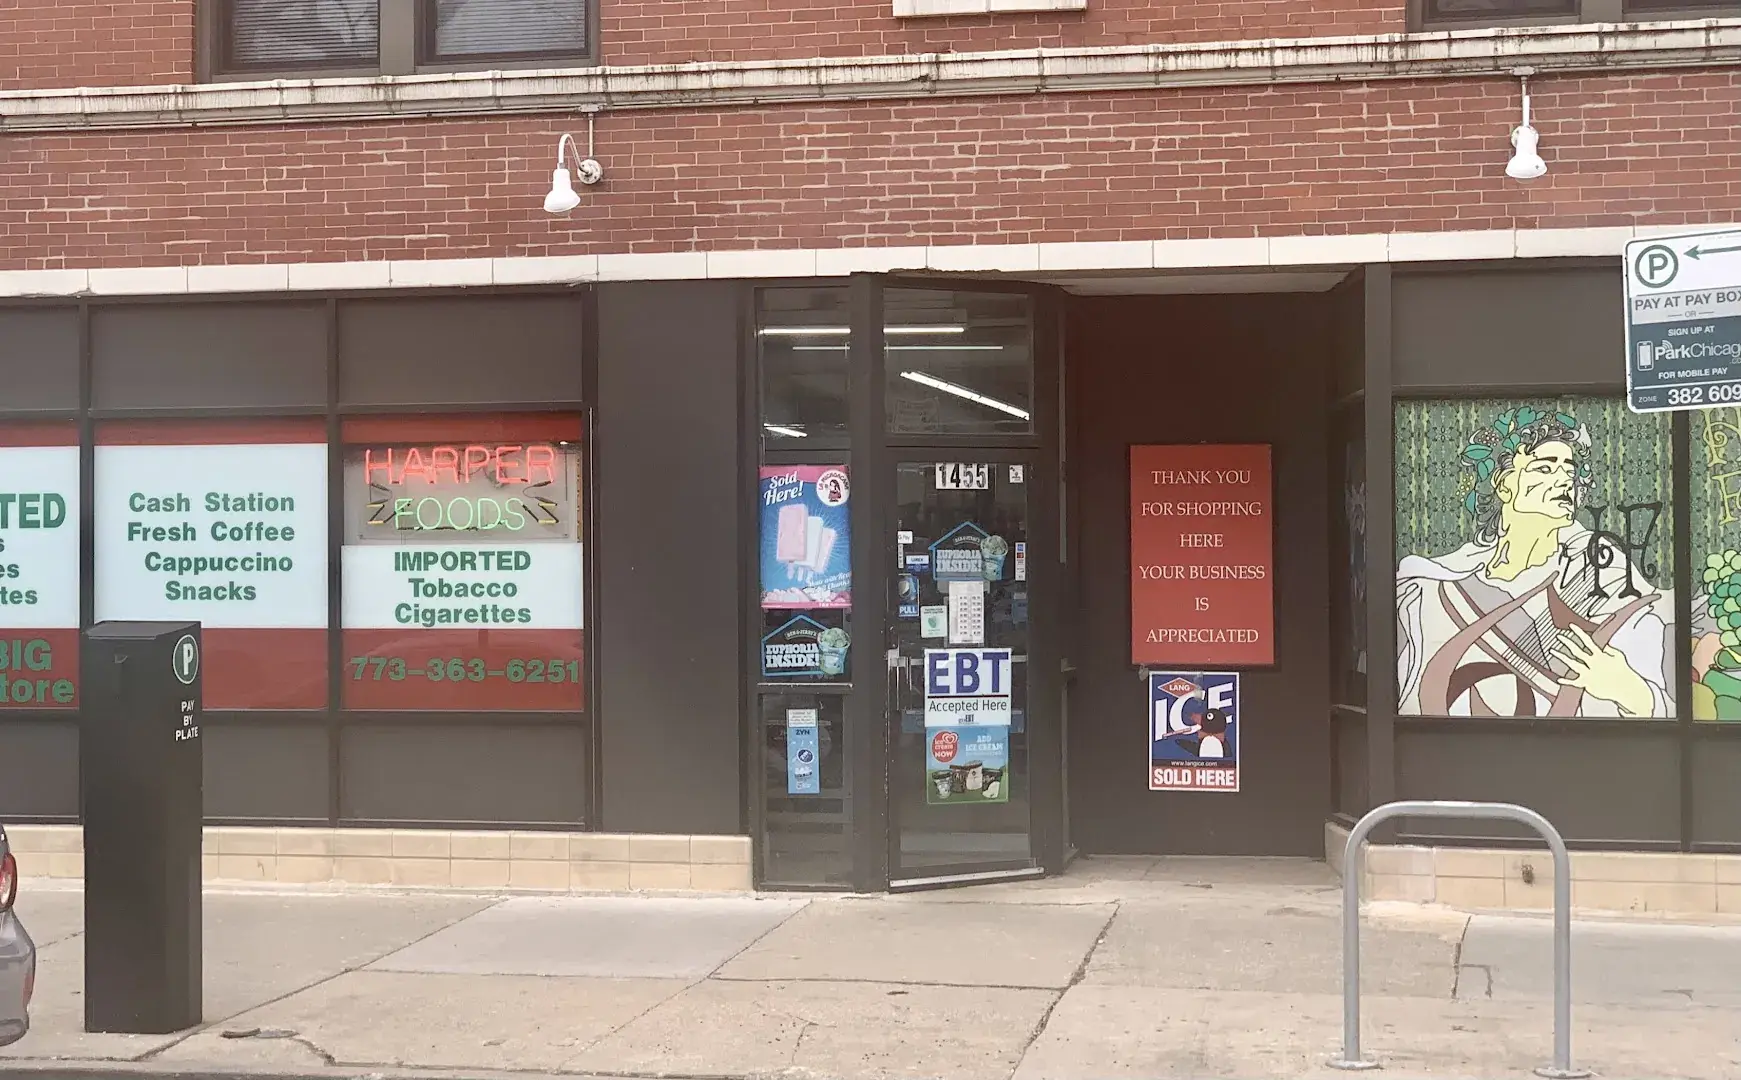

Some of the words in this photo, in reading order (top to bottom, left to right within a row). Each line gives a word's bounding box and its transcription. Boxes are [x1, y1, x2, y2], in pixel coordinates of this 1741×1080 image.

[1635, 299, 1660, 311] PAY
[1664, 296, 1681, 308] AT
[1685, 293, 1712, 306] PAY
[1668, 327, 1688, 336] SIGN
[1691, 327, 1702, 335] UP
[1704, 325, 1715, 334] AT
[1658, 371, 1675, 380] FOR
[1678, 368, 1709, 378] MOBILE
[1712, 367, 1728, 376] PAY
[1668, 387, 1703, 405] 382
[1709, 383, 1741, 402] 609
[364, 445, 559, 485] HARPER
[769, 471, 798, 489] Sold
[939, 463, 988, 488] 1455
[1151, 470, 1212, 485] THANK
[1216, 470, 1251, 485] YOU
[763, 480, 804, 506] Here!
[128, 492, 191, 512] Cash
[204, 492, 295, 513] Station
[1141, 502, 1173, 517] FOR
[1177, 502, 1262, 517] SHOPPING
[394, 496, 526, 531] FOODS
[127, 522, 196, 542] Fresh
[210, 522, 295, 542] Coffee
[1180, 533, 1224, 548] HERE
[144, 552, 293, 577] Cappuccino
[394, 551, 531, 572] IMPORTED
[936, 559, 982, 573] INSIDE!
[1139, 565, 1185, 580] YOUR
[1189, 565, 1265, 580] BUSINESS
[165, 581, 257, 601] Snacks
[408, 578, 518, 599] Tobacco
[900, 605, 916, 614] PULL
[1195, 597, 1209, 611] IS
[394, 603, 532, 627] Cigarettes
[1145, 628, 1259, 643] APPRECIATED
[765, 643, 819, 655] EUPHORIA
[765, 653, 820, 668] INSIDE!
[350, 657, 580, 684] 773-363-6251
[928, 652, 1009, 694] EBT
[1169, 684, 1191, 692] LANG
[181, 700, 195, 713] PAY
[928, 699, 978, 714] Accepted
[982, 699, 1007, 711] Here
[1155, 682, 1234, 742] ICE
[183, 714, 193, 727] BY
[175, 726, 199, 742] PLATE
[1171, 760, 1218, 768] www.langice.com
[1154, 768, 1192, 786] SOLD
[1195, 769, 1235, 787] HERE
